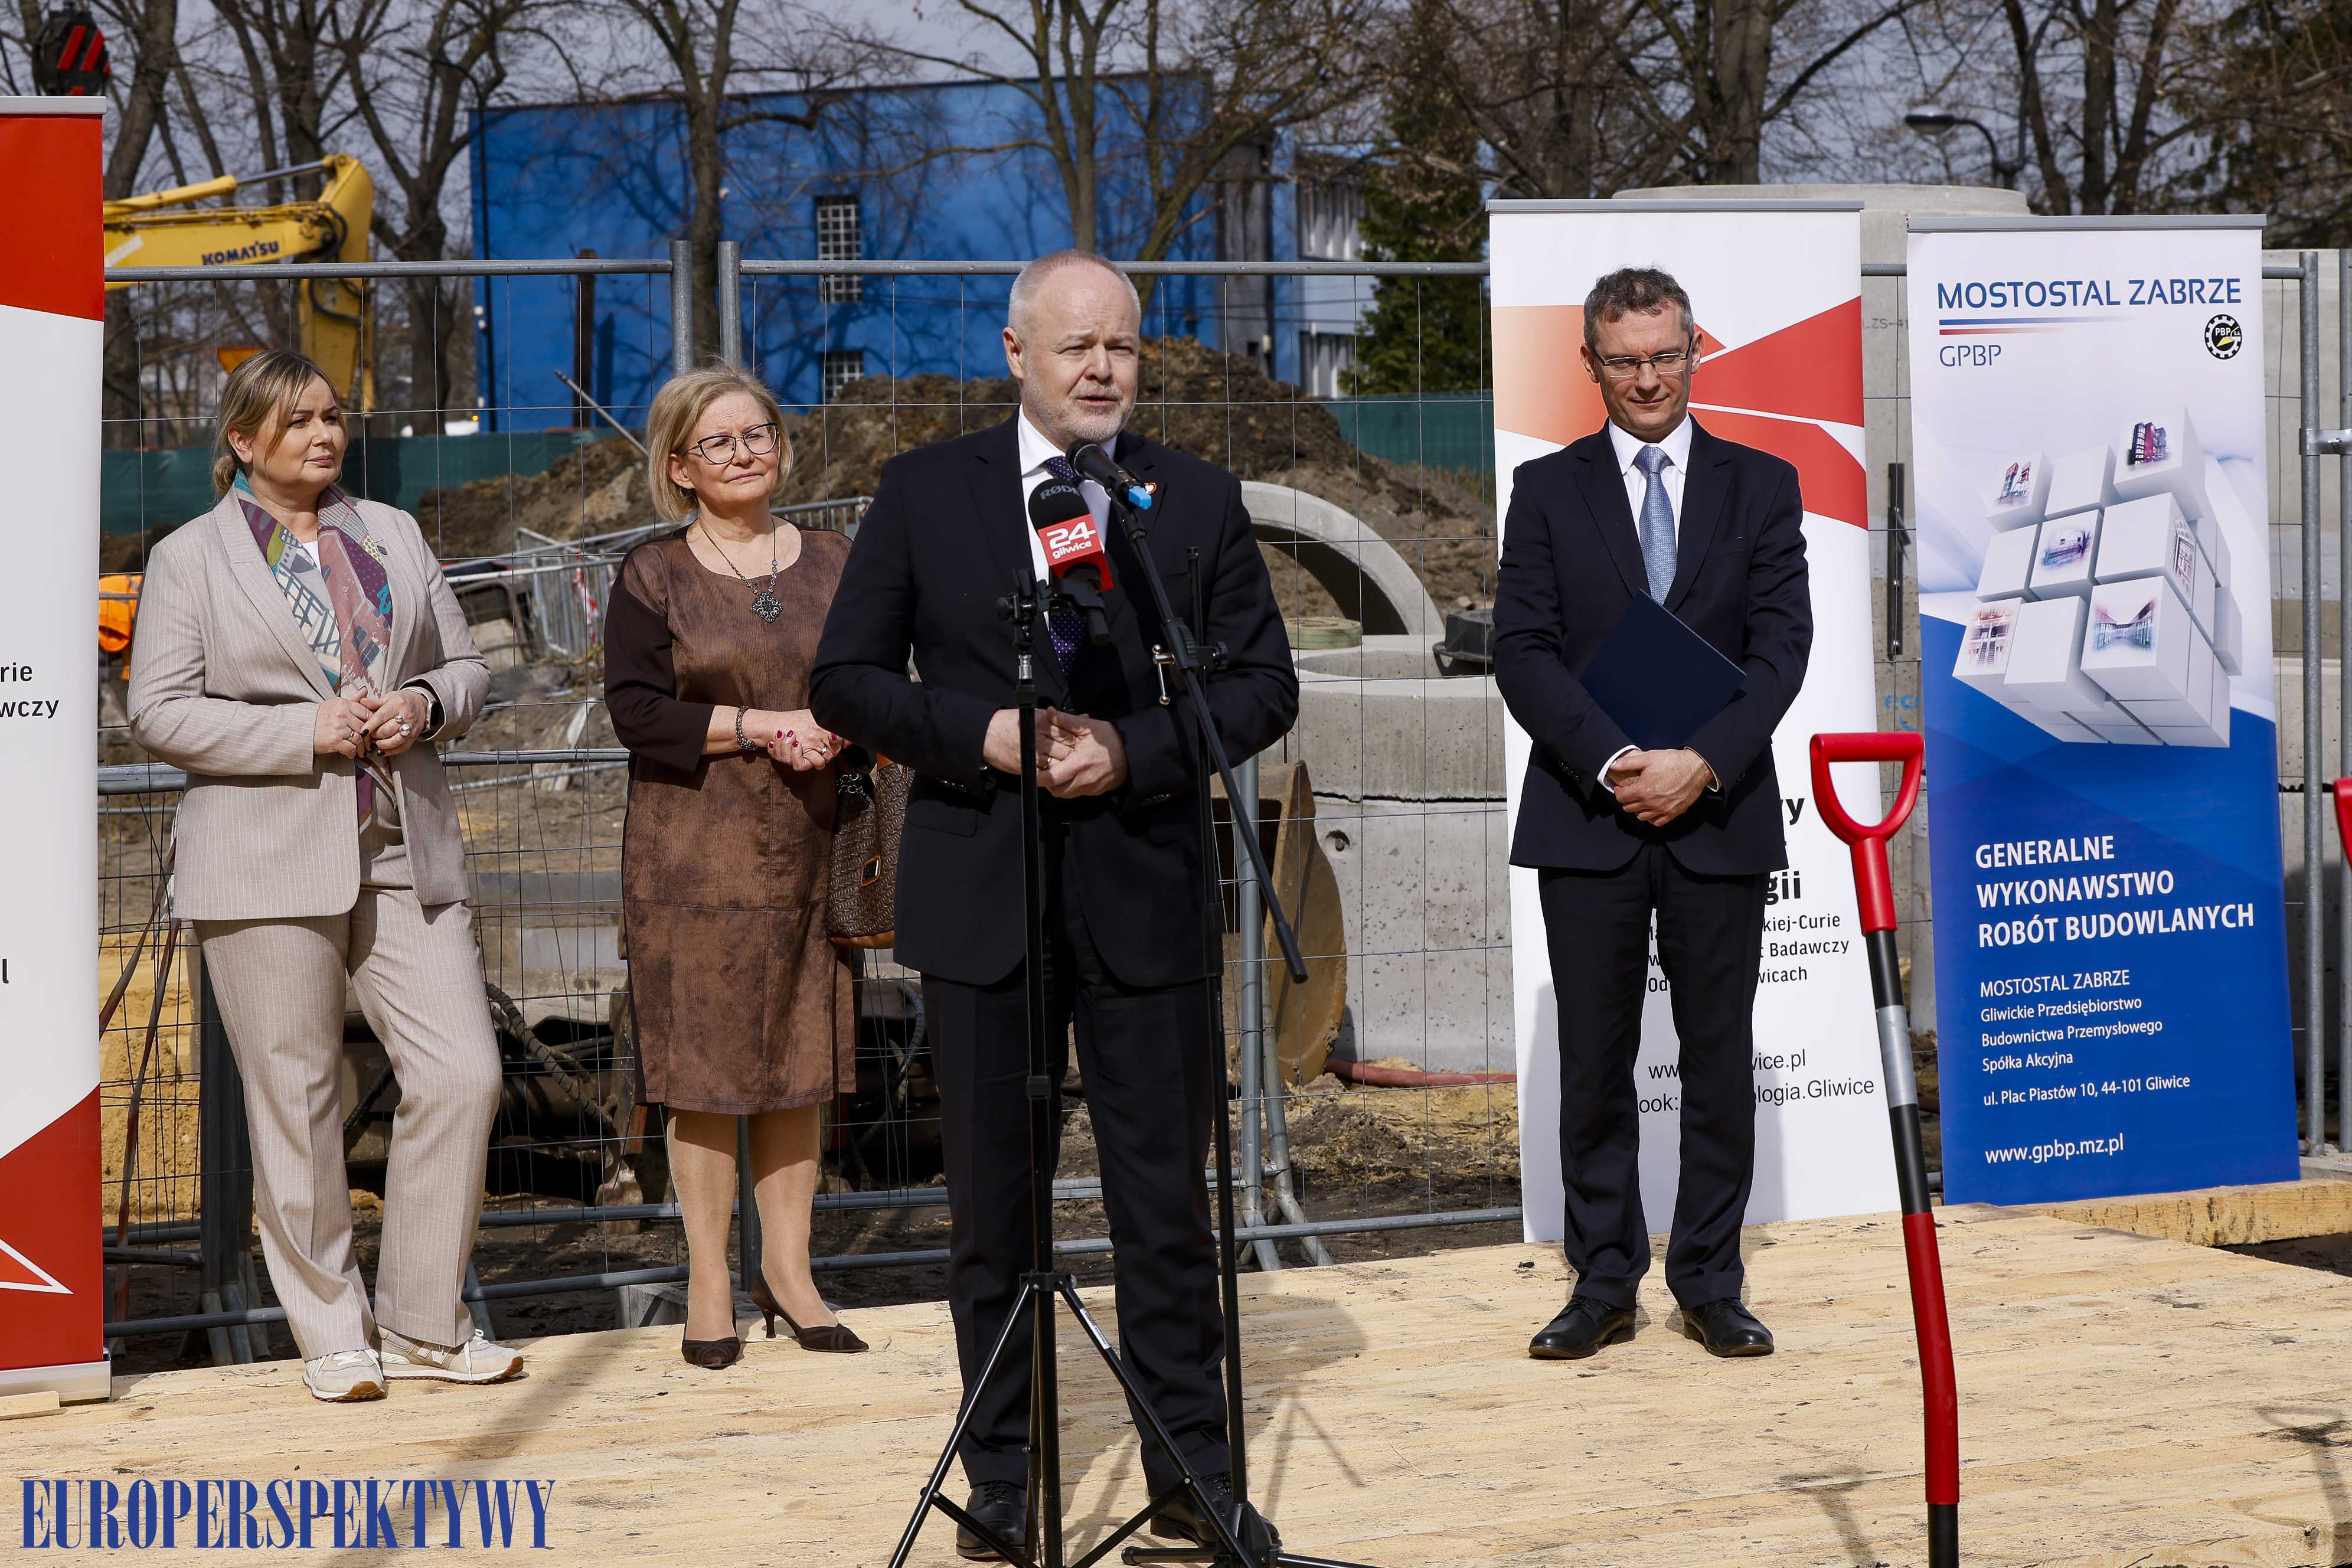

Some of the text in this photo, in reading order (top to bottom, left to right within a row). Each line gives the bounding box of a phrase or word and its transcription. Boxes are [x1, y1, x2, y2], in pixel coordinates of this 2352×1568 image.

[202, 240, 279, 265] KOMATSU
[1938, 277, 2242, 309] MOSTOSTAL ZABRZE
[2215, 327, 2231, 336] PBP
[1939, 344, 2002, 367] GPBP
[1046, 521, 1096, 550] 24
[1052, 540, 1093, 559] gliwice
[1975, 835, 2115, 868] GENERALNE
[1977, 870, 2174, 909] WYKONAWSTWO
[1979, 903, 2254, 948] ROBÓT BUDOWLANYCH
[1770, 940, 1850, 958] Badawczy
[1980, 969, 2131, 998] MOSTOSTAL ZABRZE
[1980, 997, 2142, 1023] Gliwickie Przedsiębiorstwo
[1982, 1019, 2163, 1047] Budownictwa Przemysłowego
[1982, 1052, 2073, 1074] Spółka Akcyjna
[1755, 1077, 1874, 1106] logia.Gliwice
[1984, 1074, 2191, 1106] ul. Plac Piastów 10, 44-101 Gliwice
[1985, 1133, 2124, 1164] www.gpbp.mz.pl
